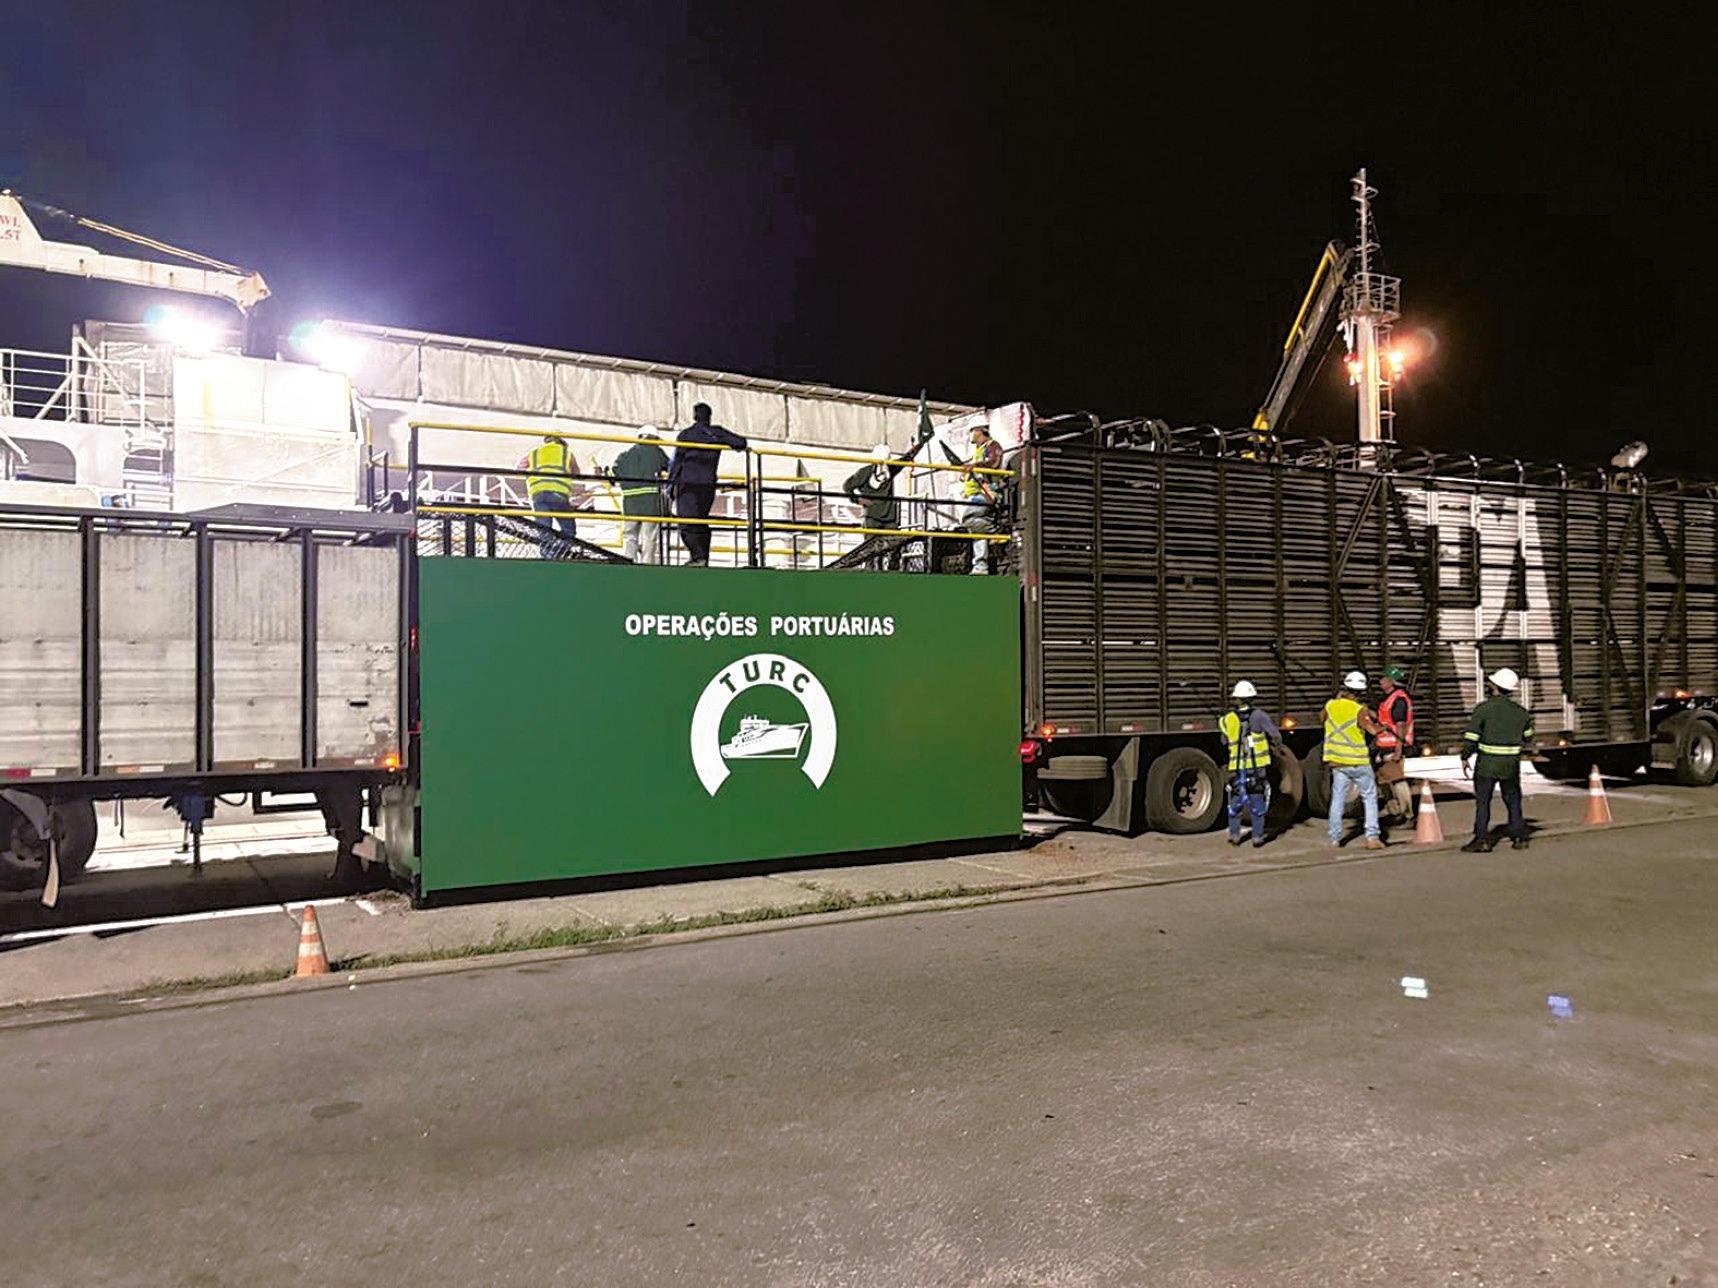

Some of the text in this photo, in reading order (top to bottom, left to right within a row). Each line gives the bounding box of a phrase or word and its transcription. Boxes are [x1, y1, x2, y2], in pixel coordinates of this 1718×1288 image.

[624, 612, 895, 641] OPERAÇÕES PORTUÁRIAS
[719, 660, 810, 693] TURC
